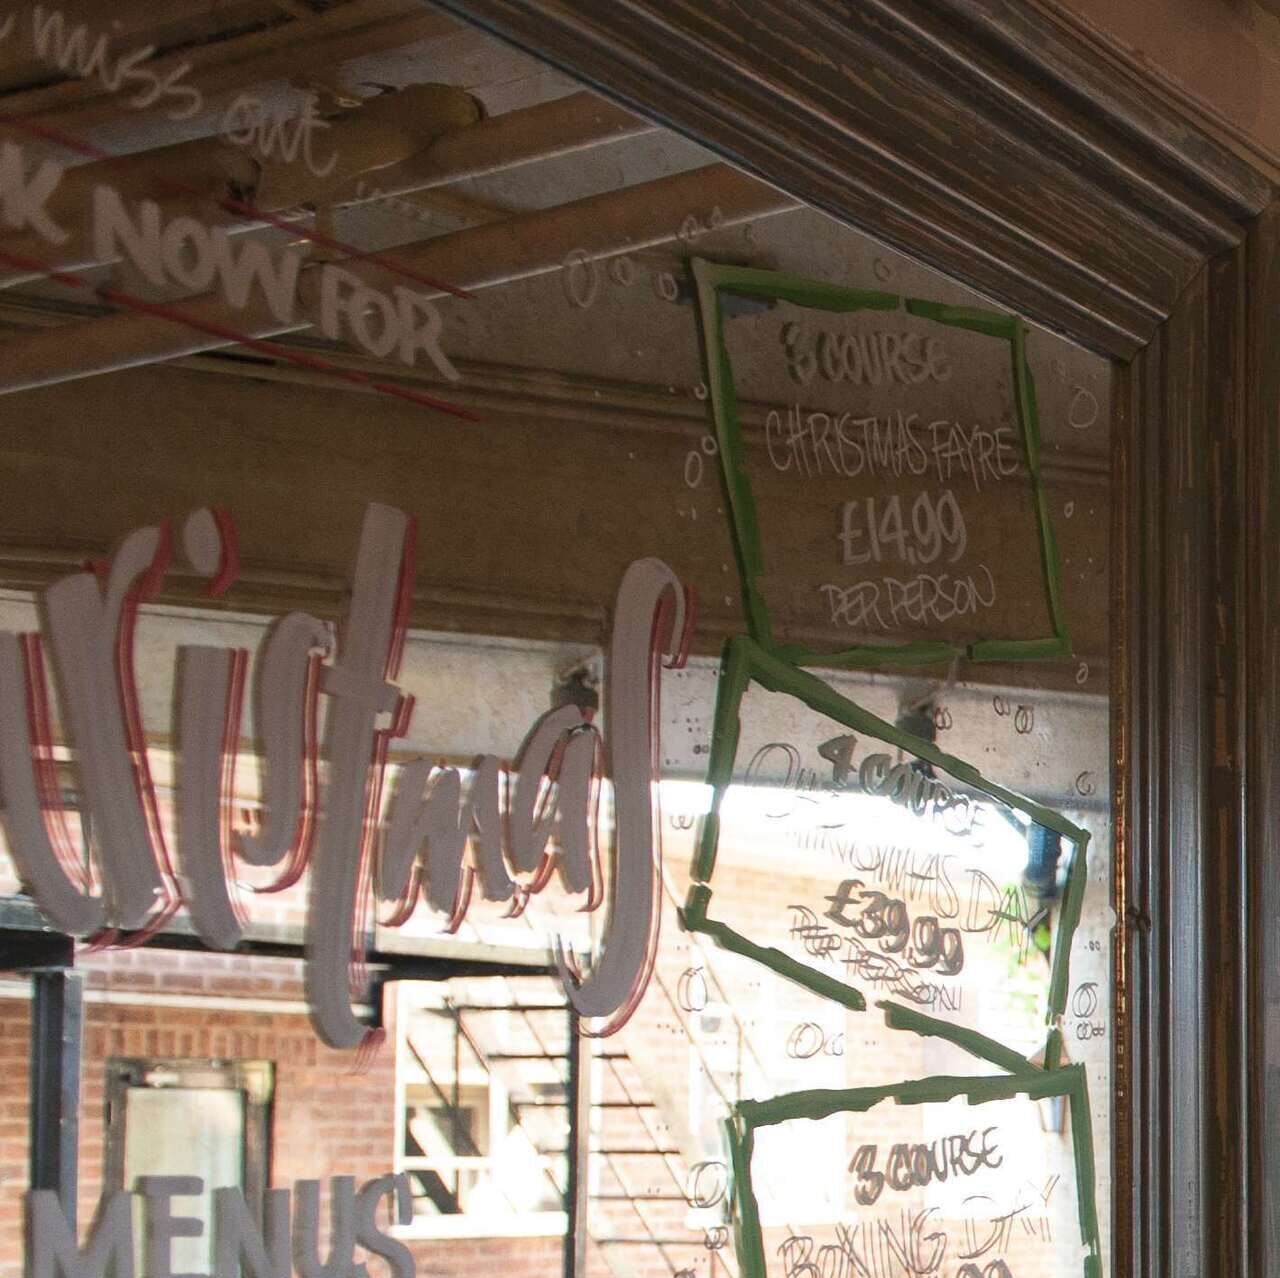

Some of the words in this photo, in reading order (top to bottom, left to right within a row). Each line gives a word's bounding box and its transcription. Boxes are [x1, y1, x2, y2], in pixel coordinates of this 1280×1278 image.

[33, 5, 201, 121] miss
[223, 92, 337, 178] out
[92, 184, 300, 328] NOW
[317, 262, 464, 382] FOR
[818, 328, 954, 386] COURSE
[765, 402, 929, 479] CHRISTMAS
[929, 419, 1020, 493] FAYRE
[836, 487, 968, 567] £14.99
[819, 577, 892, 630] PER
[883, 562, 997, 626] PERSON
[858, 752, 987, 838] COURSE
[785, 903, 843, 963] PER
[823, 878, 965, 977] £39.99
[960, 868, 1048, 968] DAY
[840, 935, 964, 1013] PERSON
[848, 1143, 886, 1206] 3
[885, 1125, 1004, 1192] COURSE
